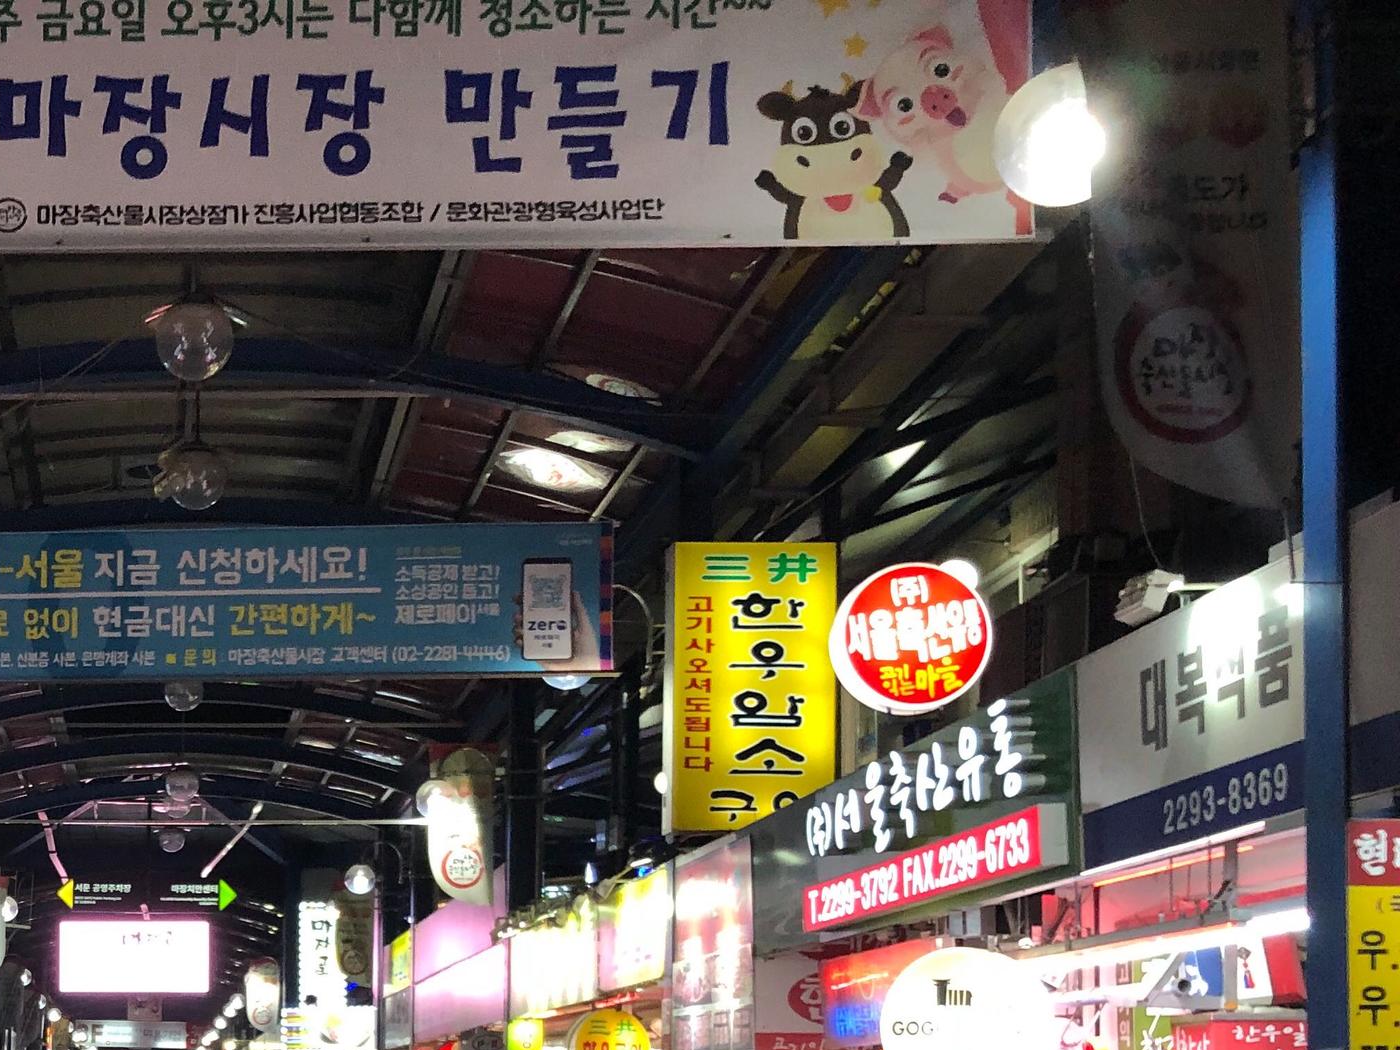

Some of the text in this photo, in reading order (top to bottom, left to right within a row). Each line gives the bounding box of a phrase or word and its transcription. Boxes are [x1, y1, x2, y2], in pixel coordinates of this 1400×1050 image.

[37, 0, 147, 42] 금요일
[161, 0, 334, 42] 오후3시는
[349, 0, 462, 38] 다함께
[444, 61, 730, 180] 만들기
[36, 202, 249, 226] 마장축산물시장상점가
[94, 548, 161, 587] 지금
[176, 546, 368, 587] 신청하세요!
[23, 606, 80, 640] 없이
[91, 600, 216, 639] 현금대신
[1162, 762, 1289, 836] 2293-8369
